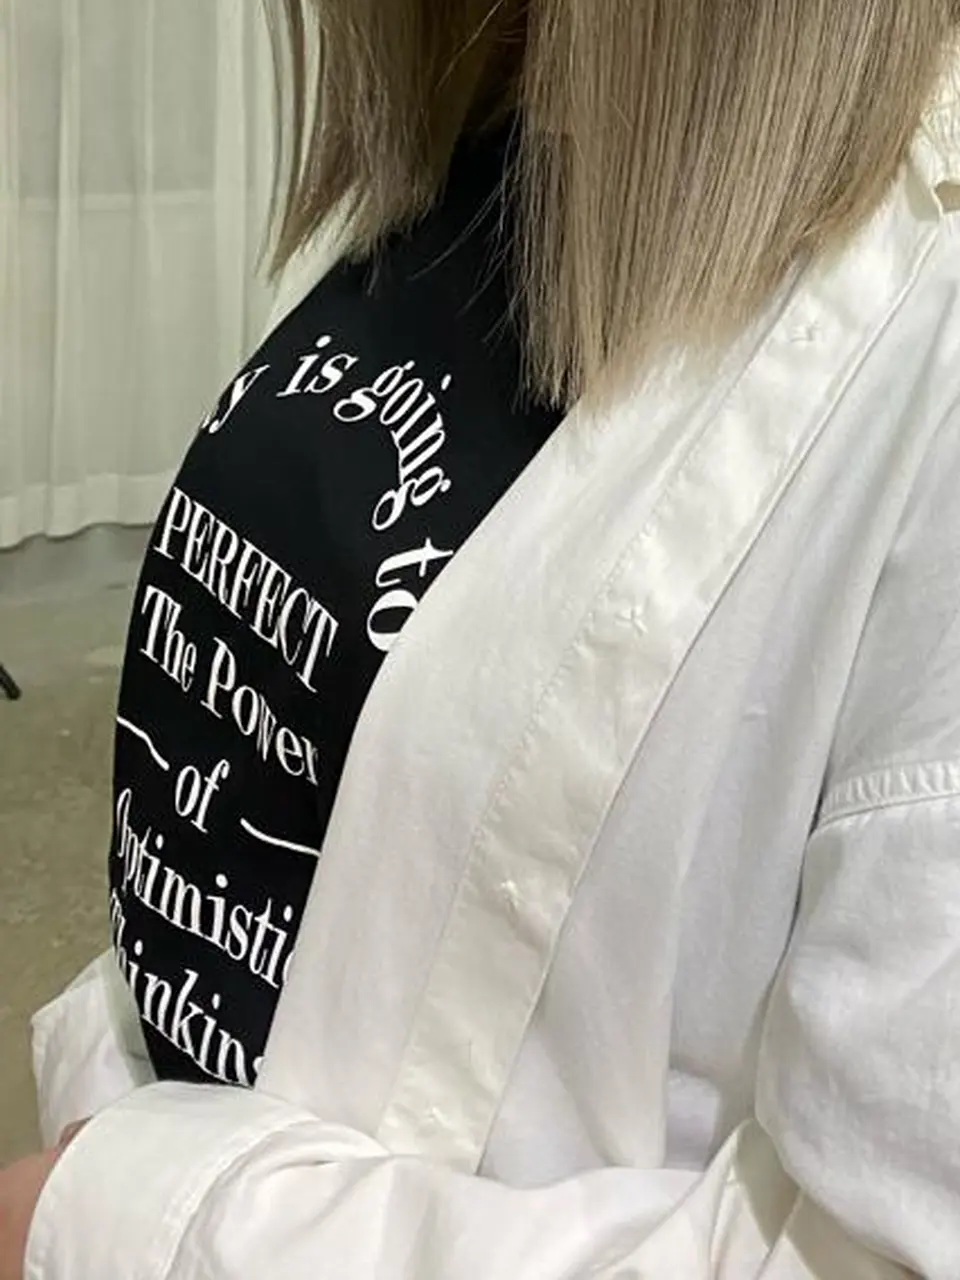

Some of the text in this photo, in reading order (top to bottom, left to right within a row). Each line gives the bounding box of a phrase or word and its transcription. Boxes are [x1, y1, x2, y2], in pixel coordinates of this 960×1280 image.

[153, 486, 339, 693] PERFECT
[201, 335, 453, 652] y is going to
[140, 585, 319, 786] The Power
[175, 759, 230, 834] of
